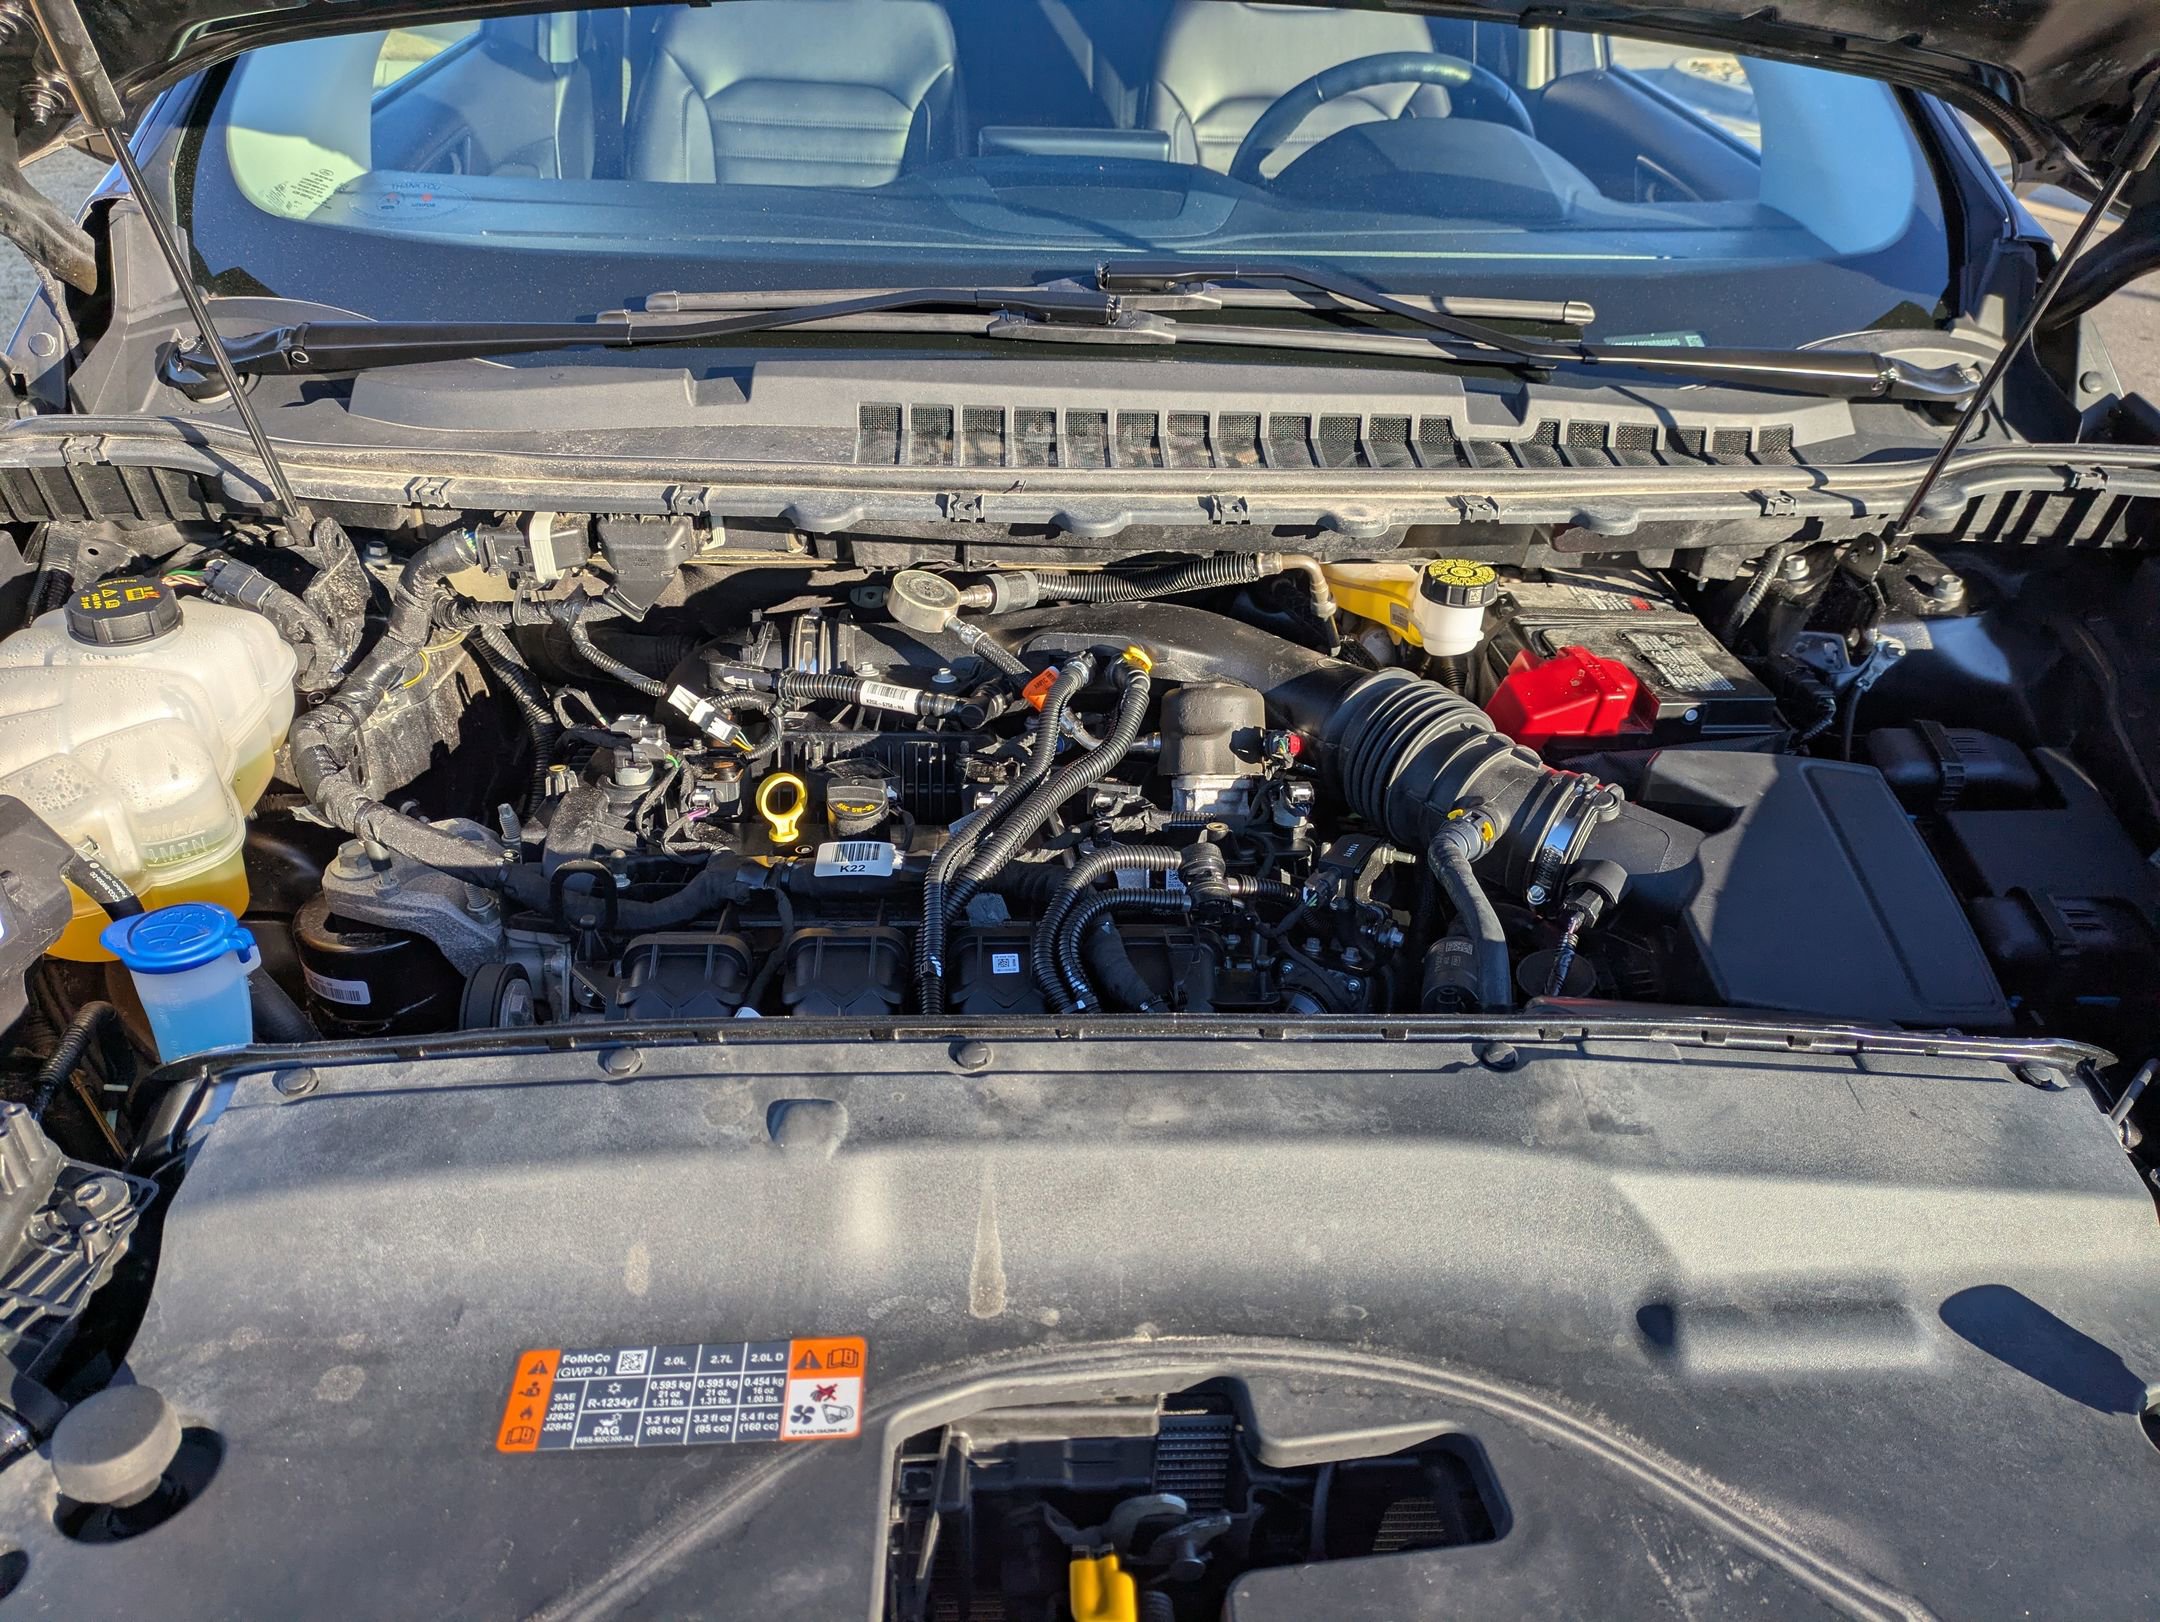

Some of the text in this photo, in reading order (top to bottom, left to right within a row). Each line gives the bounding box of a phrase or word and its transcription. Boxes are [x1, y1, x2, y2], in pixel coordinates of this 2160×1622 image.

[160, 837, 207, 862] MIN
[840, 864, 866, 873] K22
[562, 1354, 611, 1364] FoMoCo
[664, 1356, 687, 1366] 2.0L
[710, 1354, 733, 1364] 2.7L
[751, 1353, 784, 1362] 2.0L D
[556, 1365, 608, 1378] (GWP 4)
[650, 1380, 692, 1391] 0.595 kg
[697, 1378, 739, 1390] 0.595 kg
[744, 1377, 785, 1388] 0.454 kg
[553, 1393, 576, 1401] SAE
[670, 1398, 684, 1406] lbs
[700, 1397, 716, 1405] 1.31
[550, 1402, 575, 1412] J639
[587, 1397, 639, 1408] R-1234yf
[645, 1415, 685, 1425] 3.2 fl oz
[693, 1413, 733, 1423] 3.2 fl oz
[740, 1411, 779, 1421] 5.4 fl oz
[593, 1426, 620, 1436] PAG
[646, 1426, 681, 1436] (95 cc)
[695, 1424, 730, 1435] (95 cc)
[739, 1422, 779, 1433] (160 cc)
